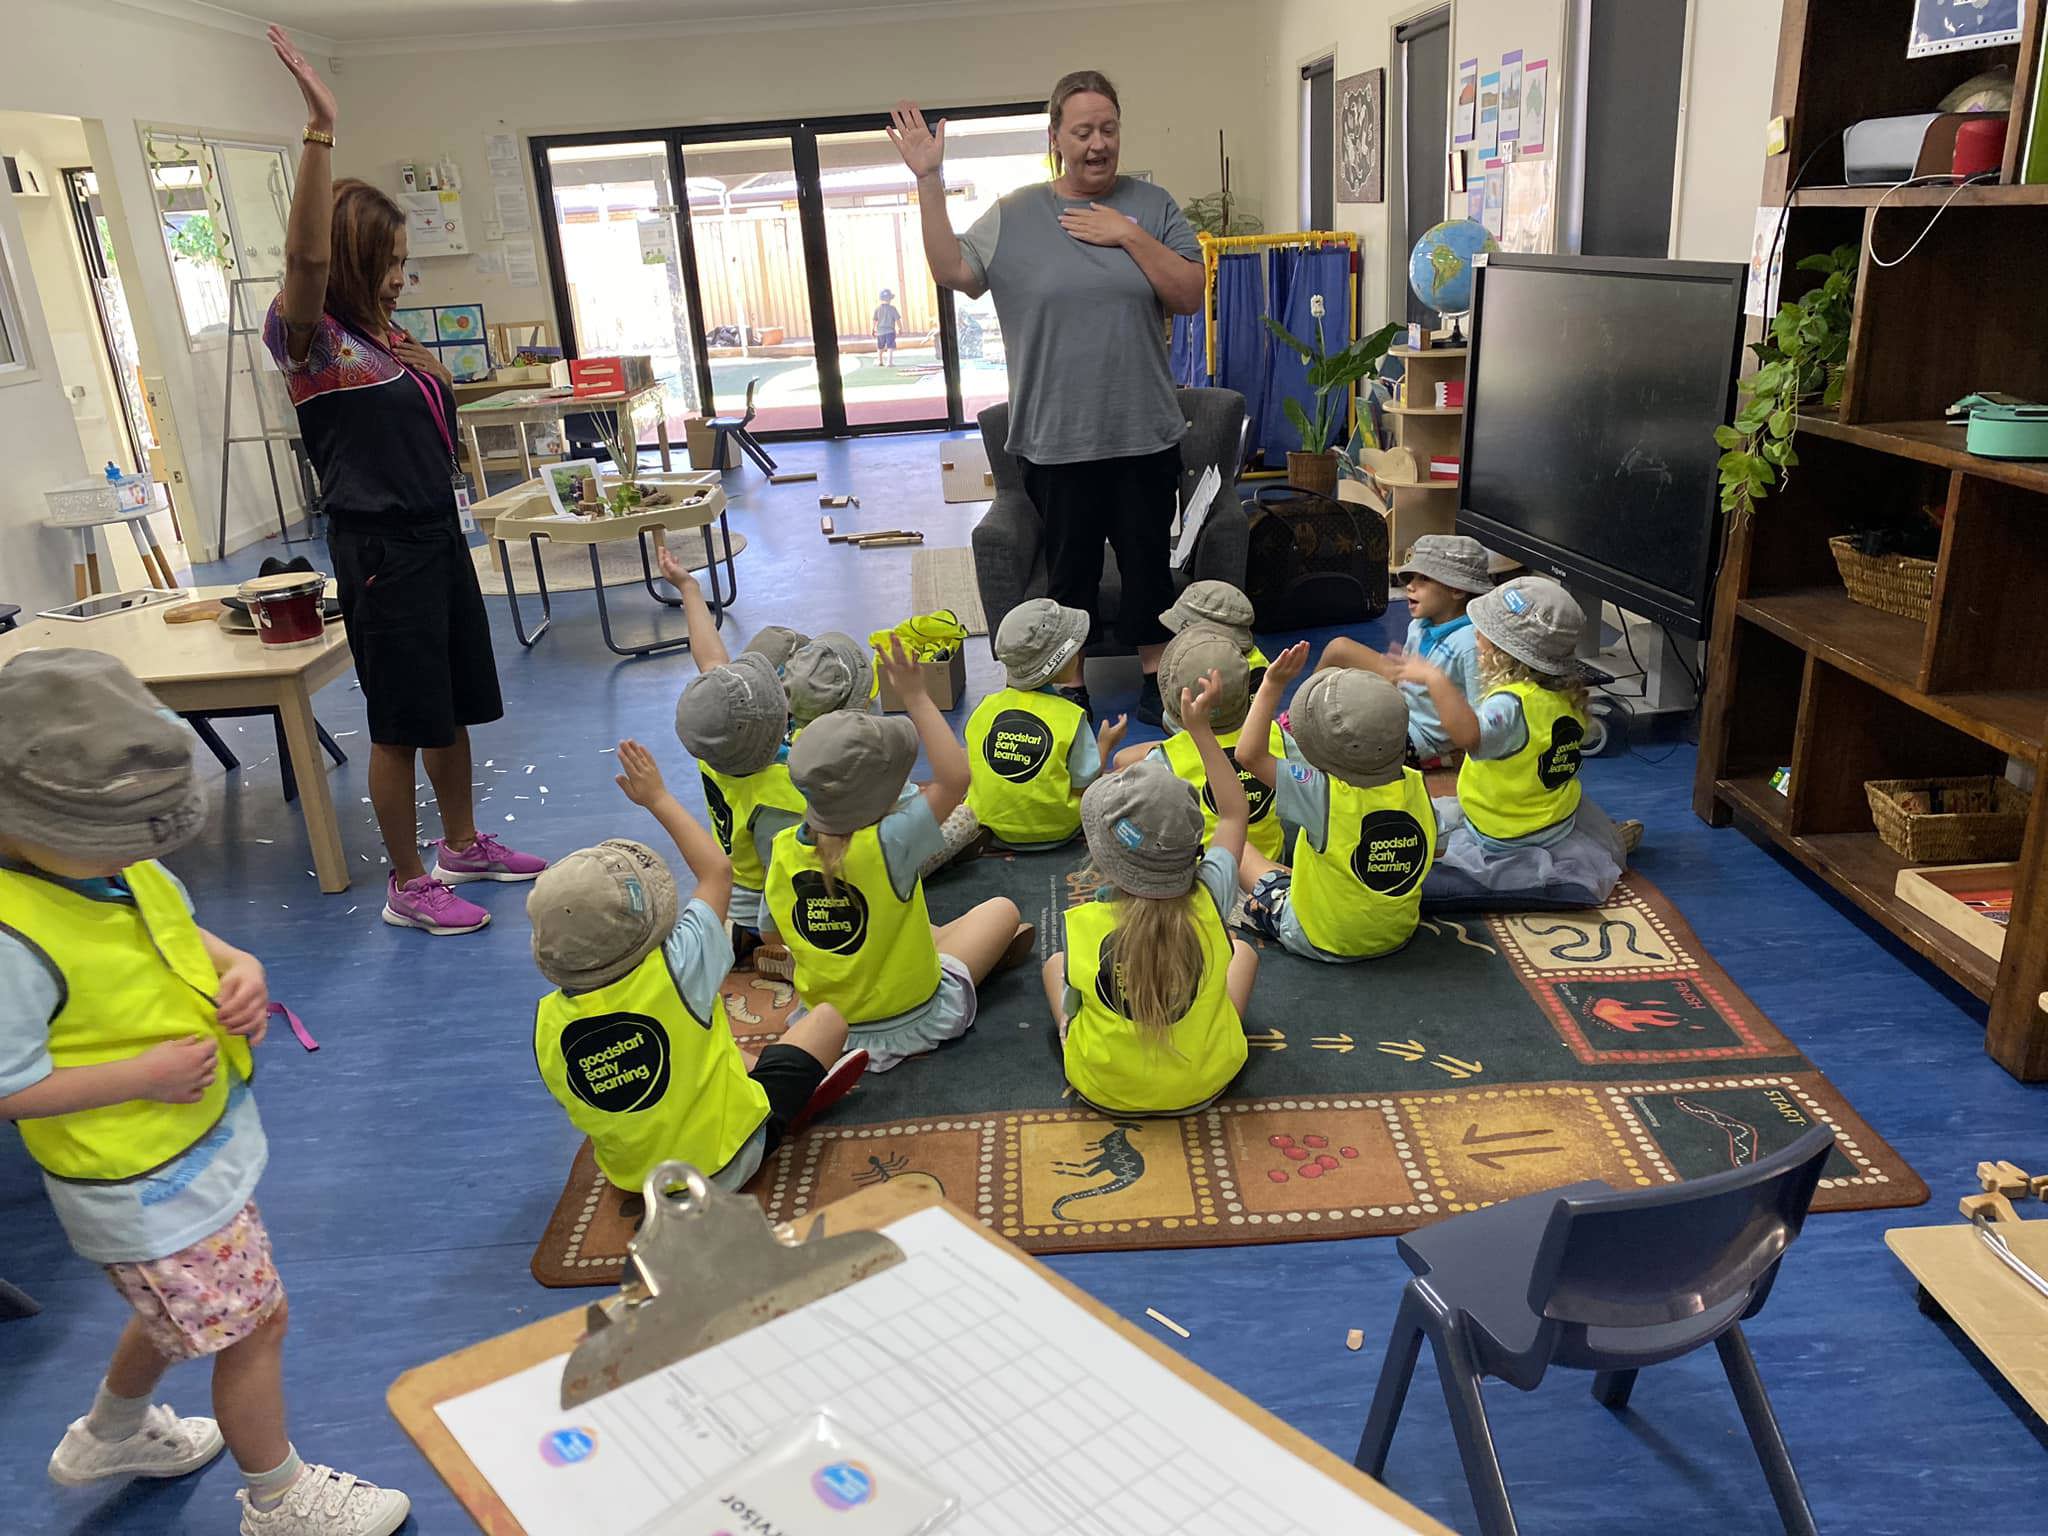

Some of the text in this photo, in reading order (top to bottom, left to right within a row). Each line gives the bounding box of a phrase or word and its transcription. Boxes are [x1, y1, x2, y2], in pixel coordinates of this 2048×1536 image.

[997, 731, 1042, 745] goodstart
[995, 741, 1018, 752] early
[993, 749, 1031, 765] learning
[1370, 834, 1418, 853] goodstart
[1368, 849, 1396, 863] early
[1367, 860, 1411, 873] learning
[806, 896, 851, 909] goodstart
[807, 908, 829, 921] early
[808, 920, 852, 932] learning
[1672, 981, 1706, 1009] FINISH
[578, 1032, 645, 1072] goodstart
[585, 1062, 619, 1081] early
[590, 1064, 651, 1095] learning
[1763, 1090, 1808, 1124] START
[720, 1495, 783, 1536] visor
